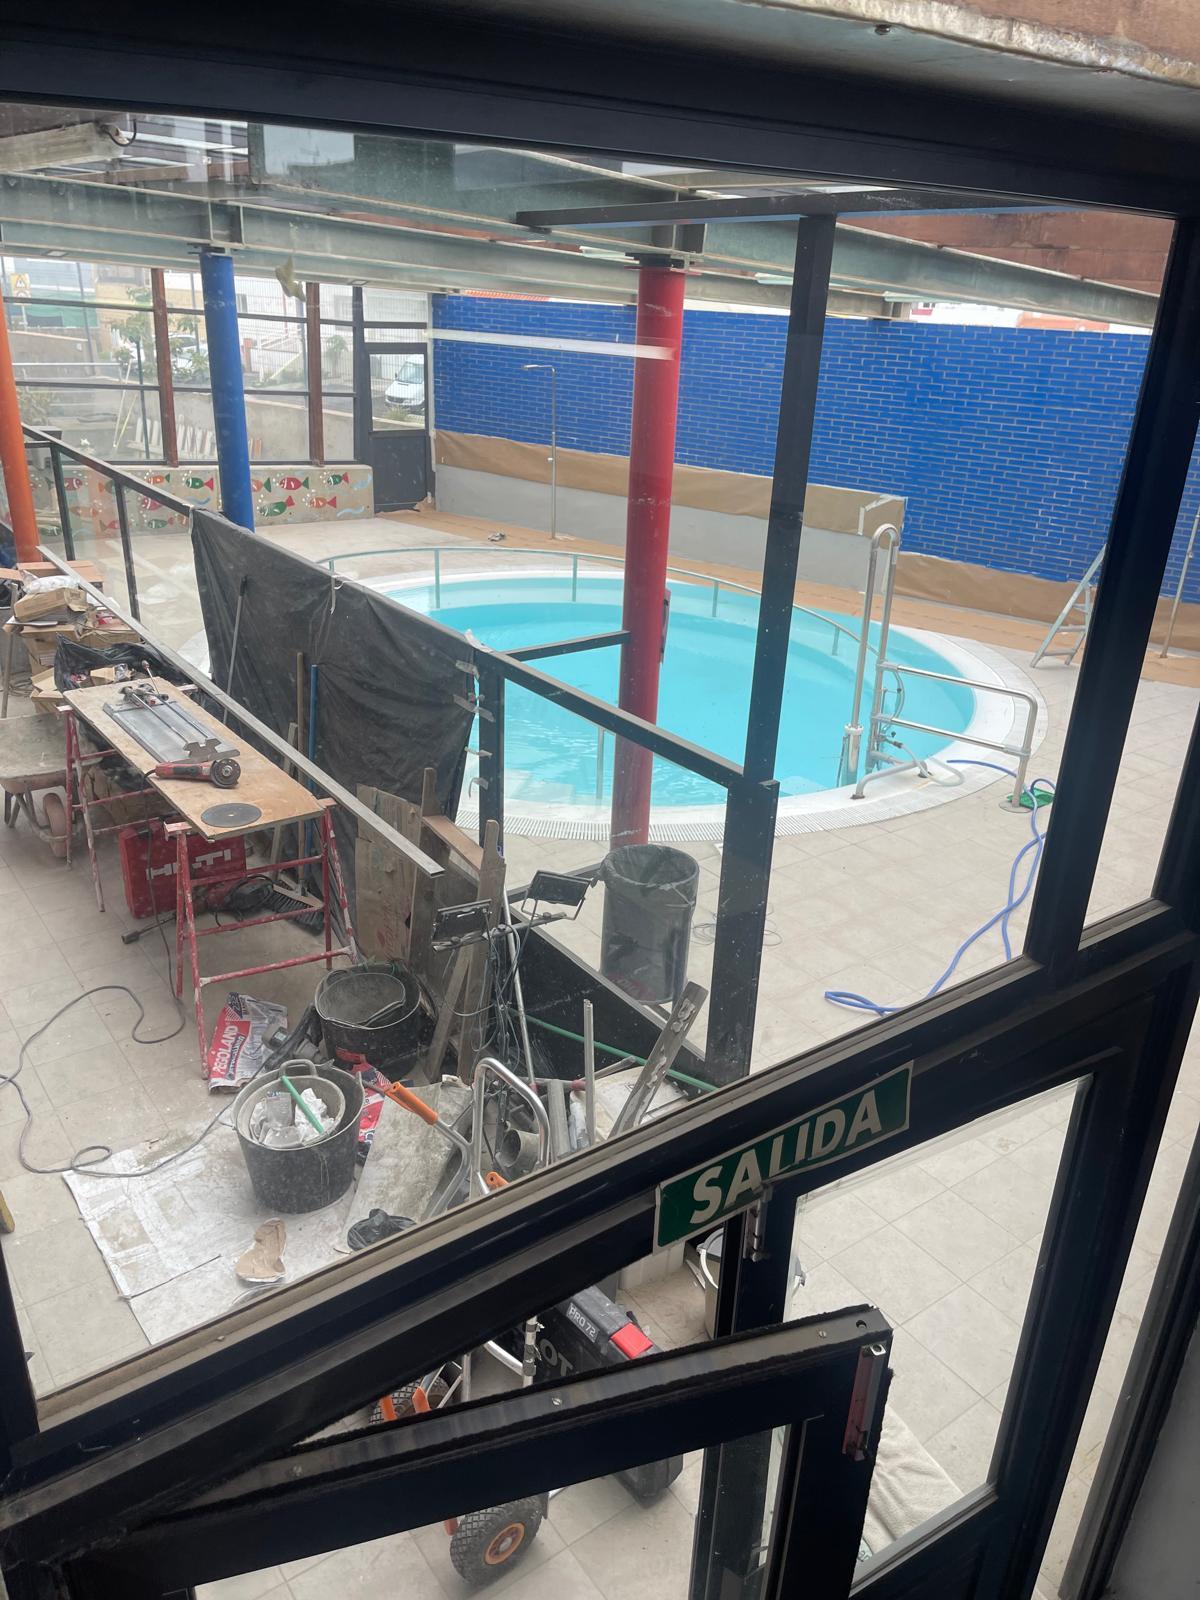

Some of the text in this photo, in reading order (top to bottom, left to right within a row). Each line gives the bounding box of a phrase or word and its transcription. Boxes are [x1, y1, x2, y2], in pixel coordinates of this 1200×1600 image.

[689, 1089, 882, 1224] SALIDA
[568, 1305, 597, 1338] PRO 72
